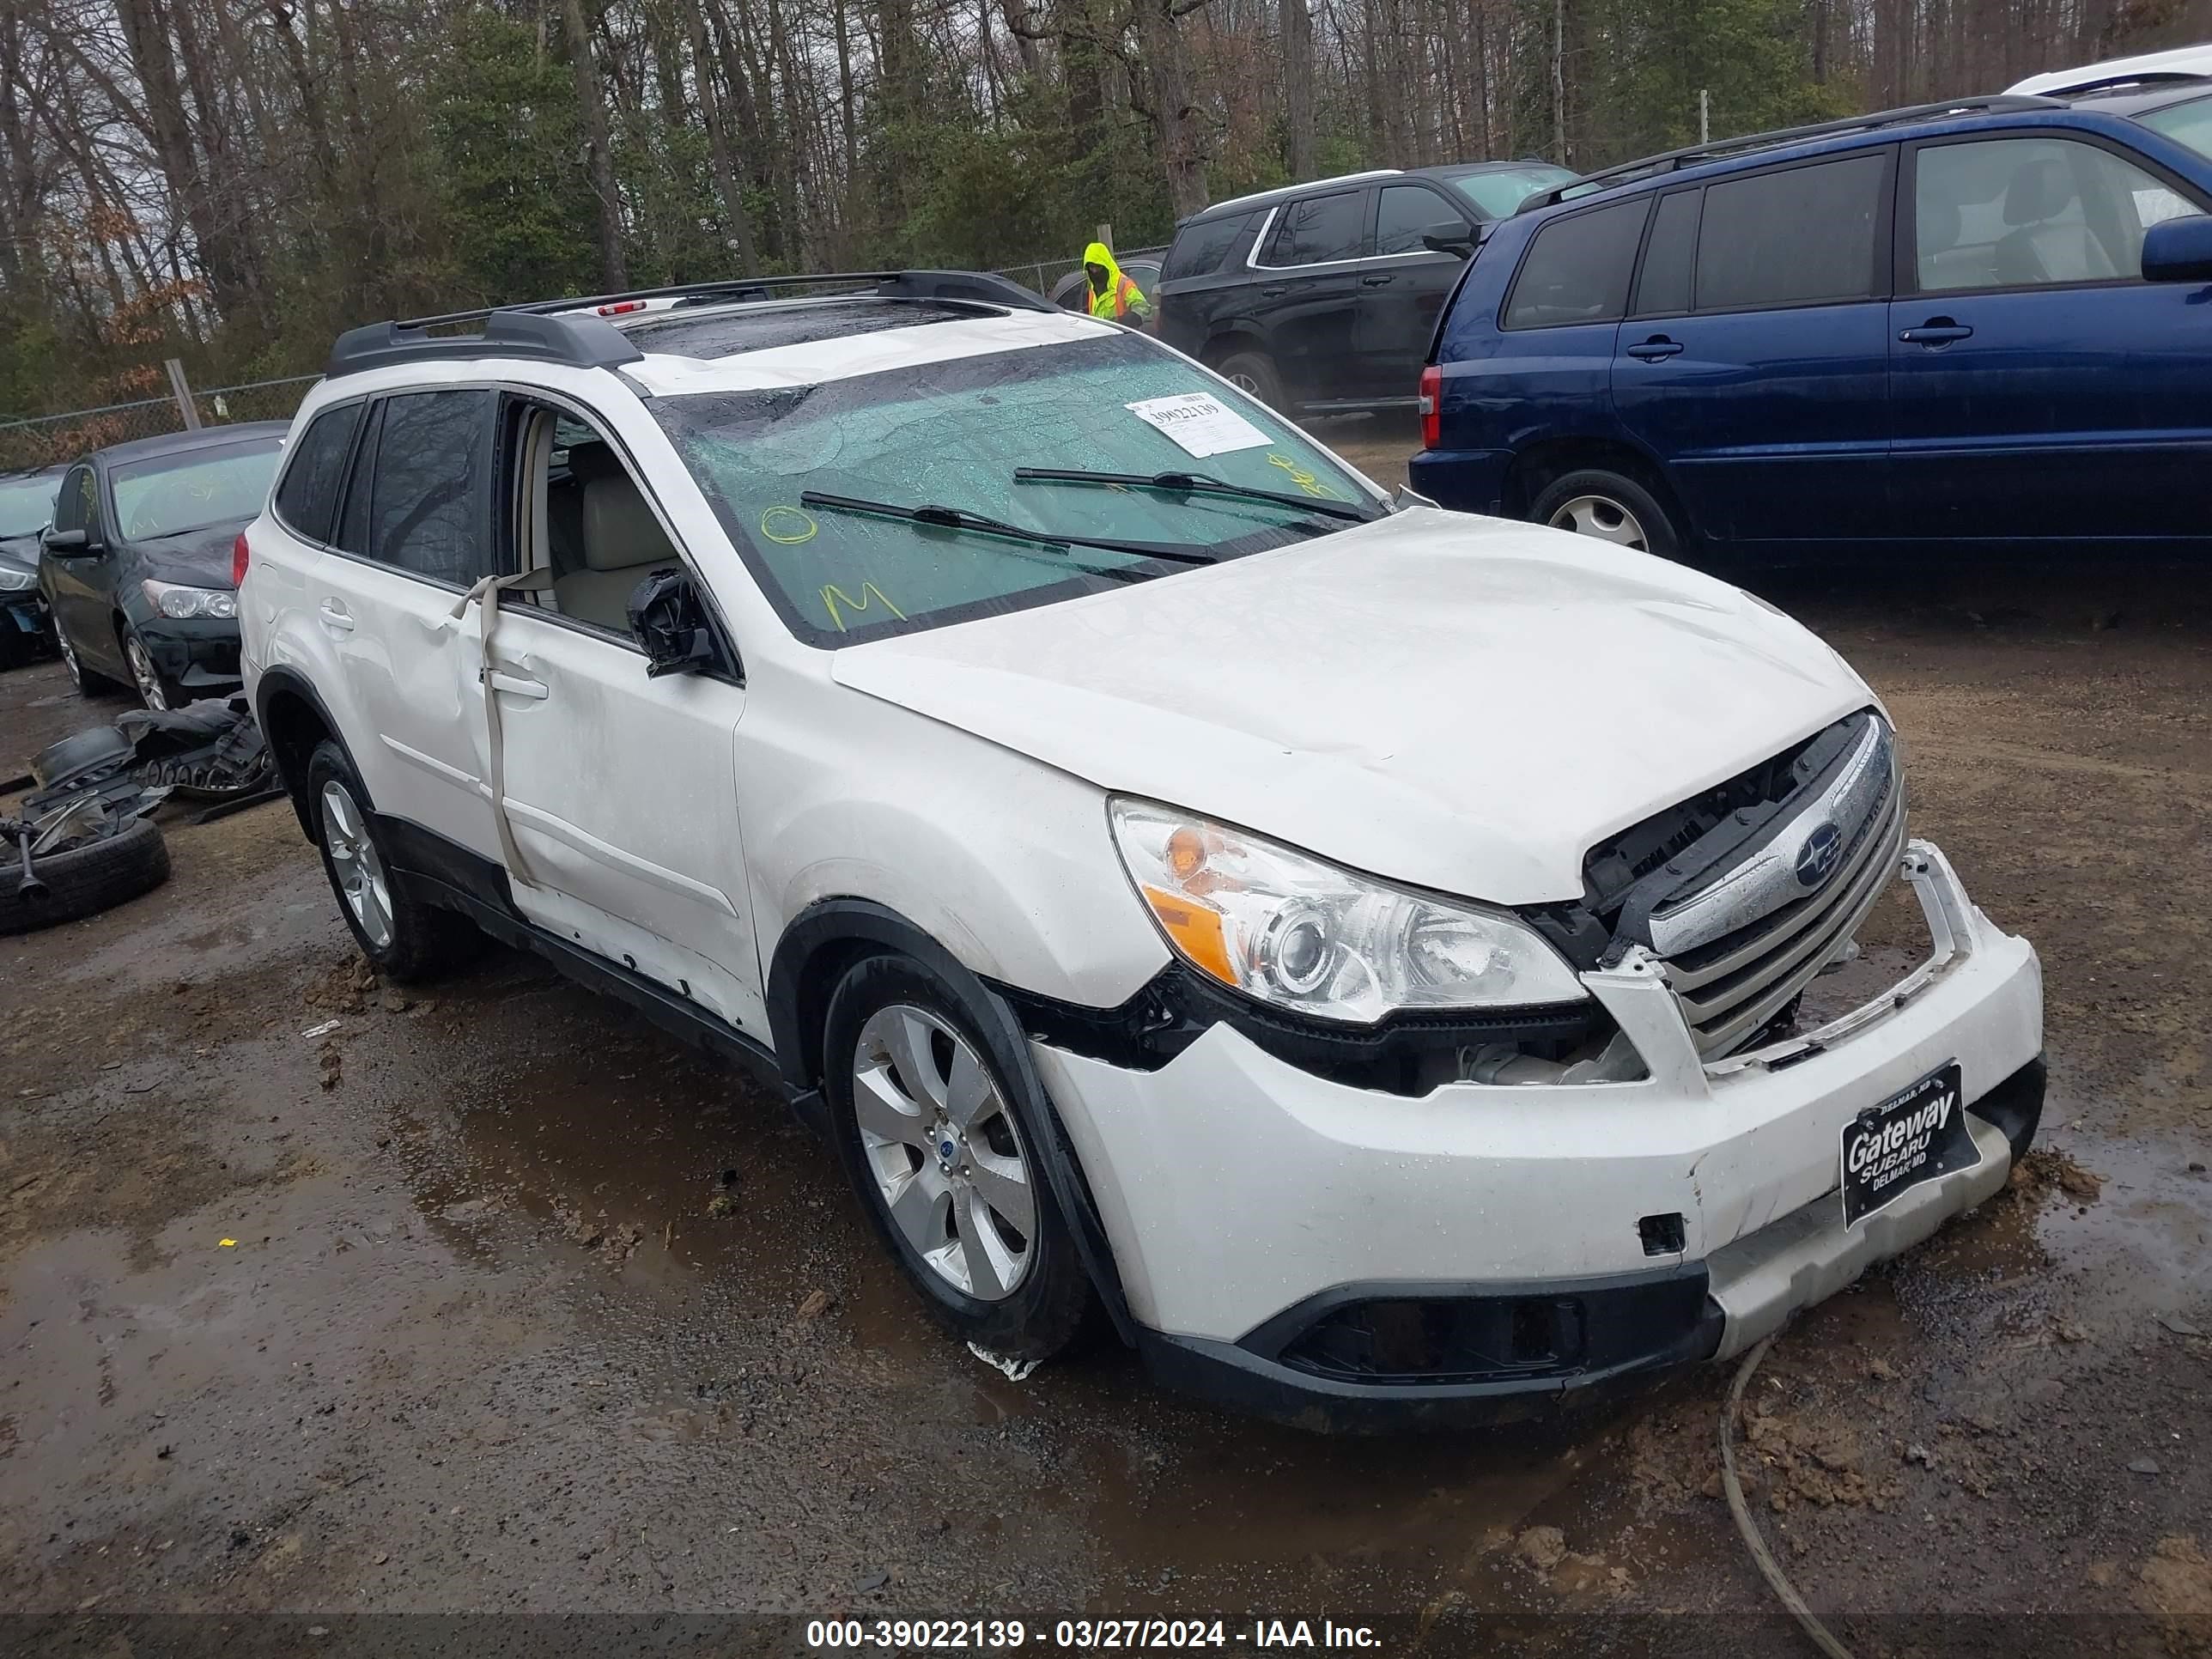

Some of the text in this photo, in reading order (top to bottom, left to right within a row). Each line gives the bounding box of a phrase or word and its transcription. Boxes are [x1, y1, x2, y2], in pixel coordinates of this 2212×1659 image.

[1151, 403, 1220, 424] 39022139
[1849, 1091, 1955, 1174] Gateway
[1860, 1131, 1932, 1184] SUBARU
[1911, 1151, 1927, 1170] MD
